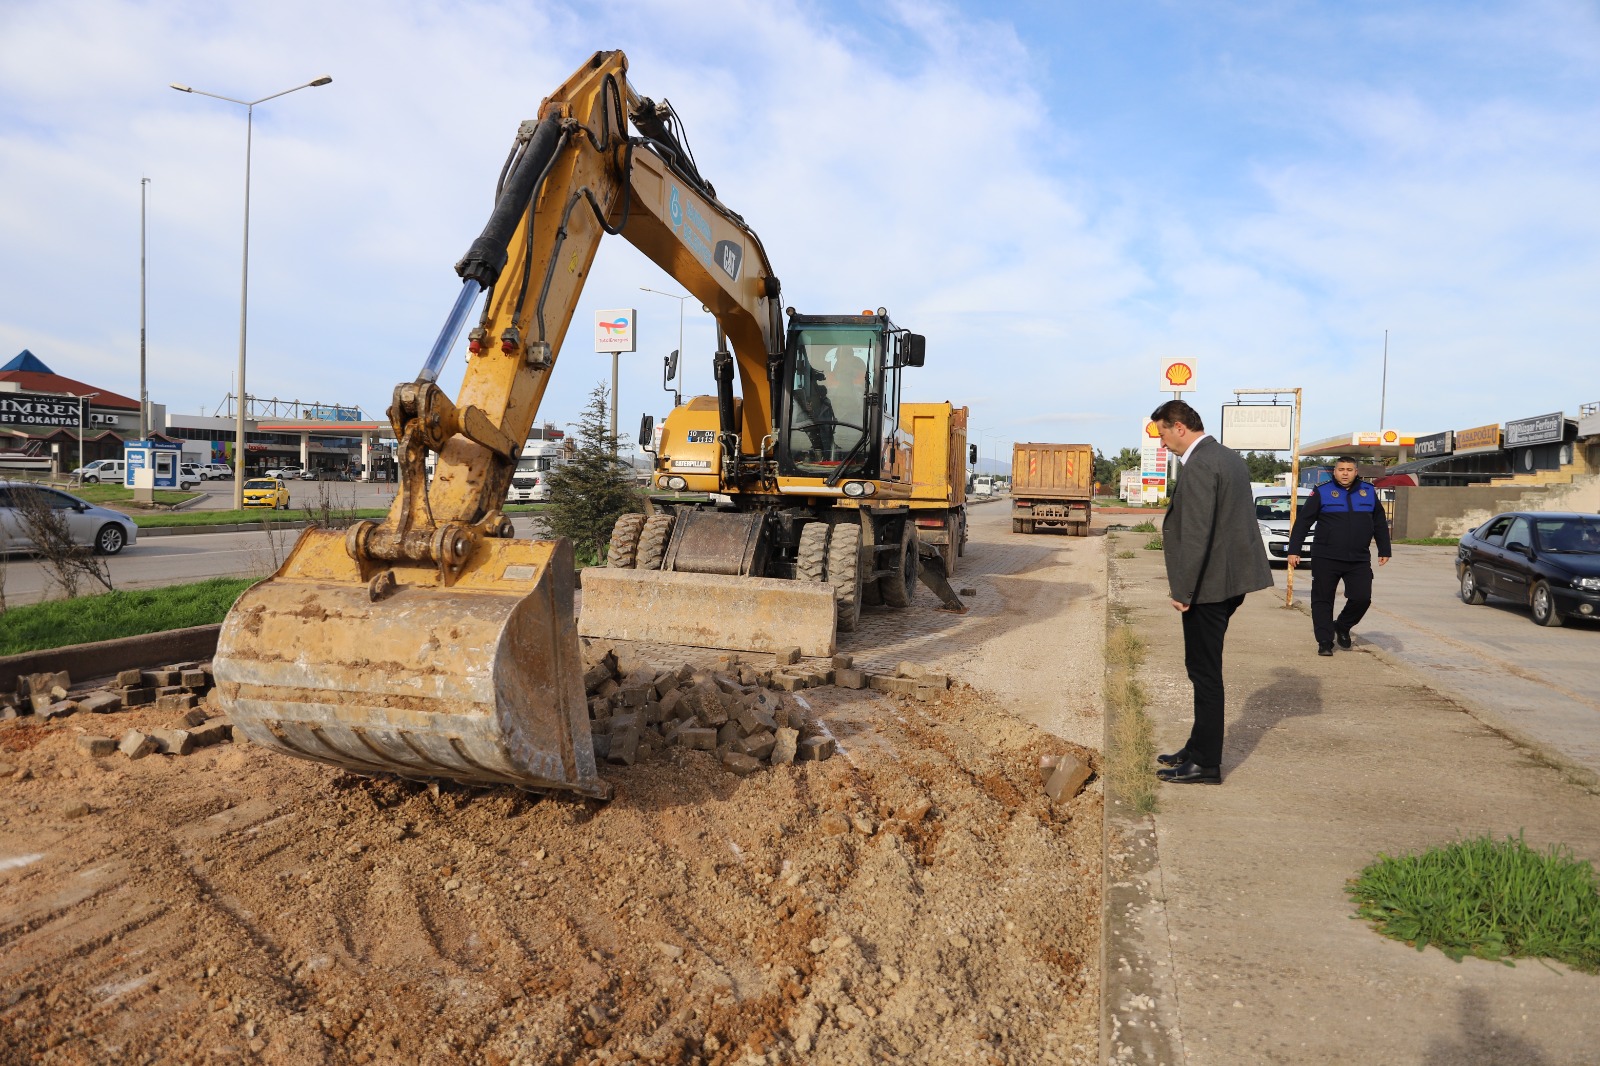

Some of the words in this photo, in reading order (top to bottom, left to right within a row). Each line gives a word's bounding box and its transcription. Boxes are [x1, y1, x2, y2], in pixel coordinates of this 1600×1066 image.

[723, 244, 736, 278] CAT
[1, 414, 16, 422] ET
[21, 415, 81, 425] LOKANTAS
